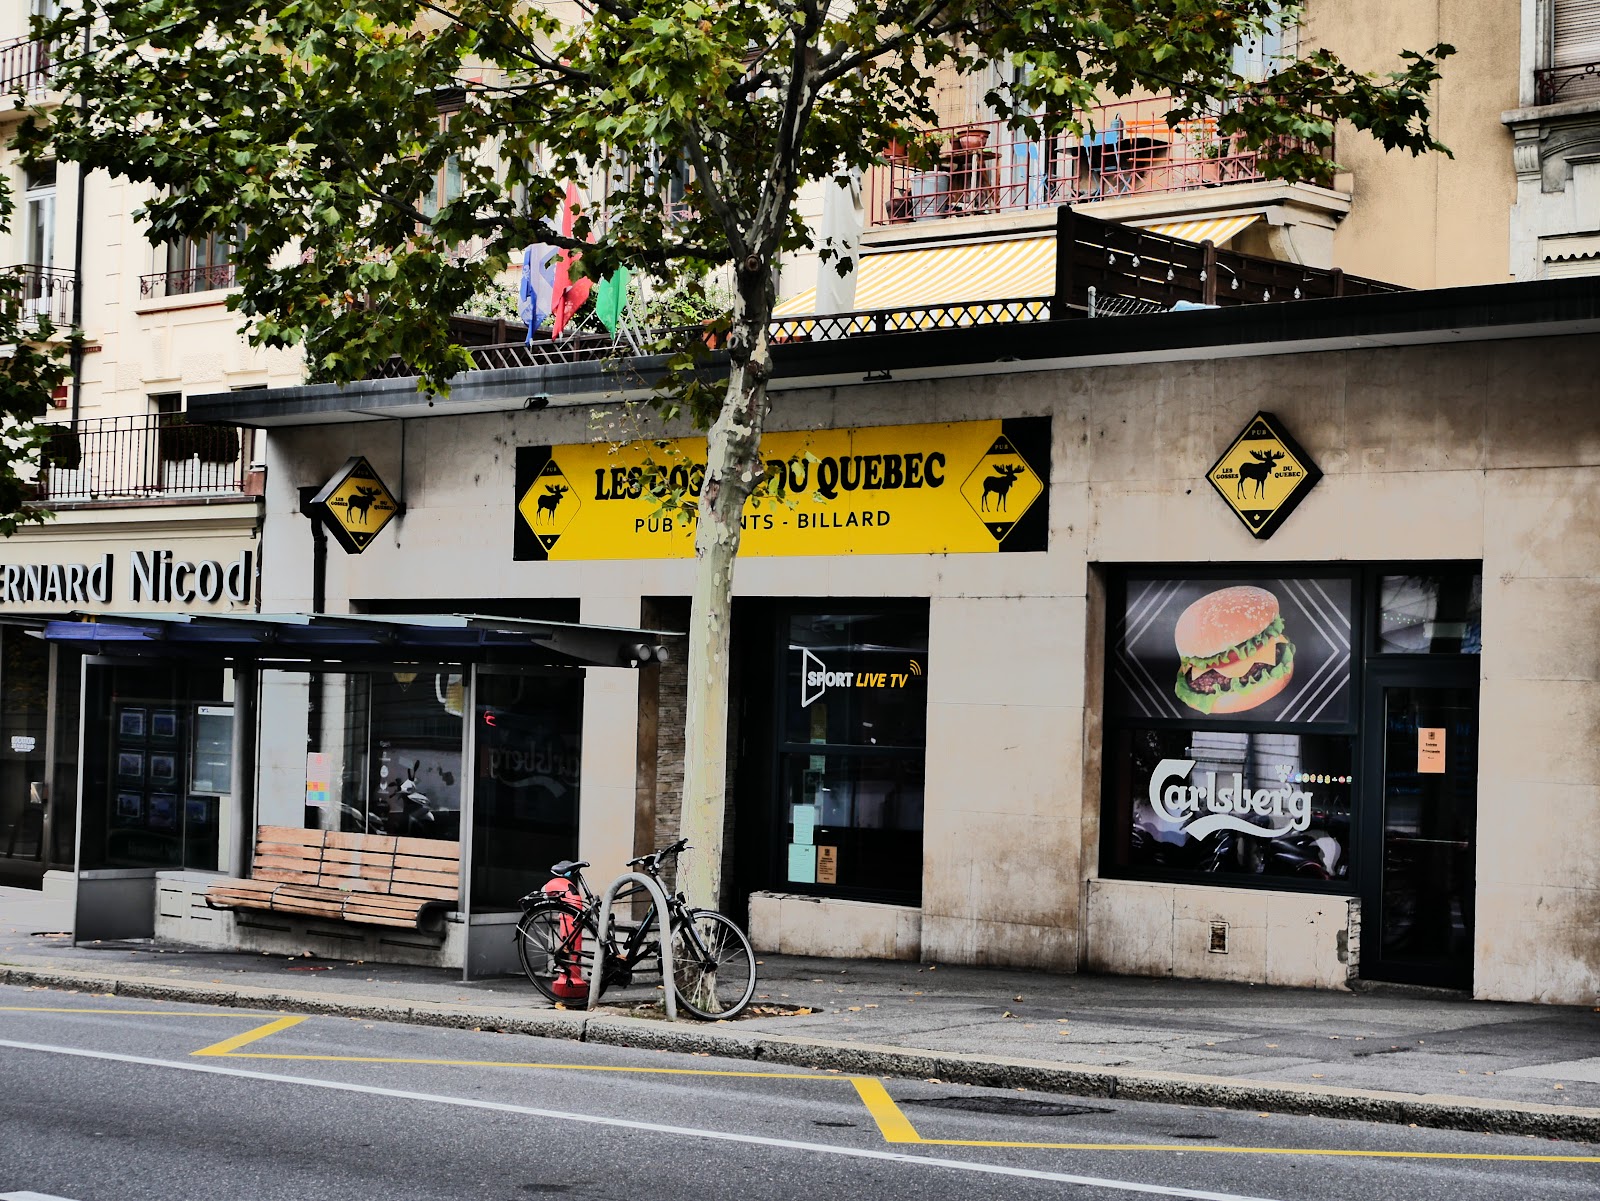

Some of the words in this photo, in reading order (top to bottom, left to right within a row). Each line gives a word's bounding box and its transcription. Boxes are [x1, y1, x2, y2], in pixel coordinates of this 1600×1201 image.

[594, 466, 642, 501] LES
[765, 457, 809, 494] DU
[816, 451, 946, 500] QUEBEC
[635, 517, 673, 534] PUB
[797, 510, 891, 529] BILLARD
[806, 671, 854, 688] SPORT
[855, 672, 888, 688] LIVE
[889, 673, 909, 689] TV
[1148, 757, 1314, 836] Carlsberg
